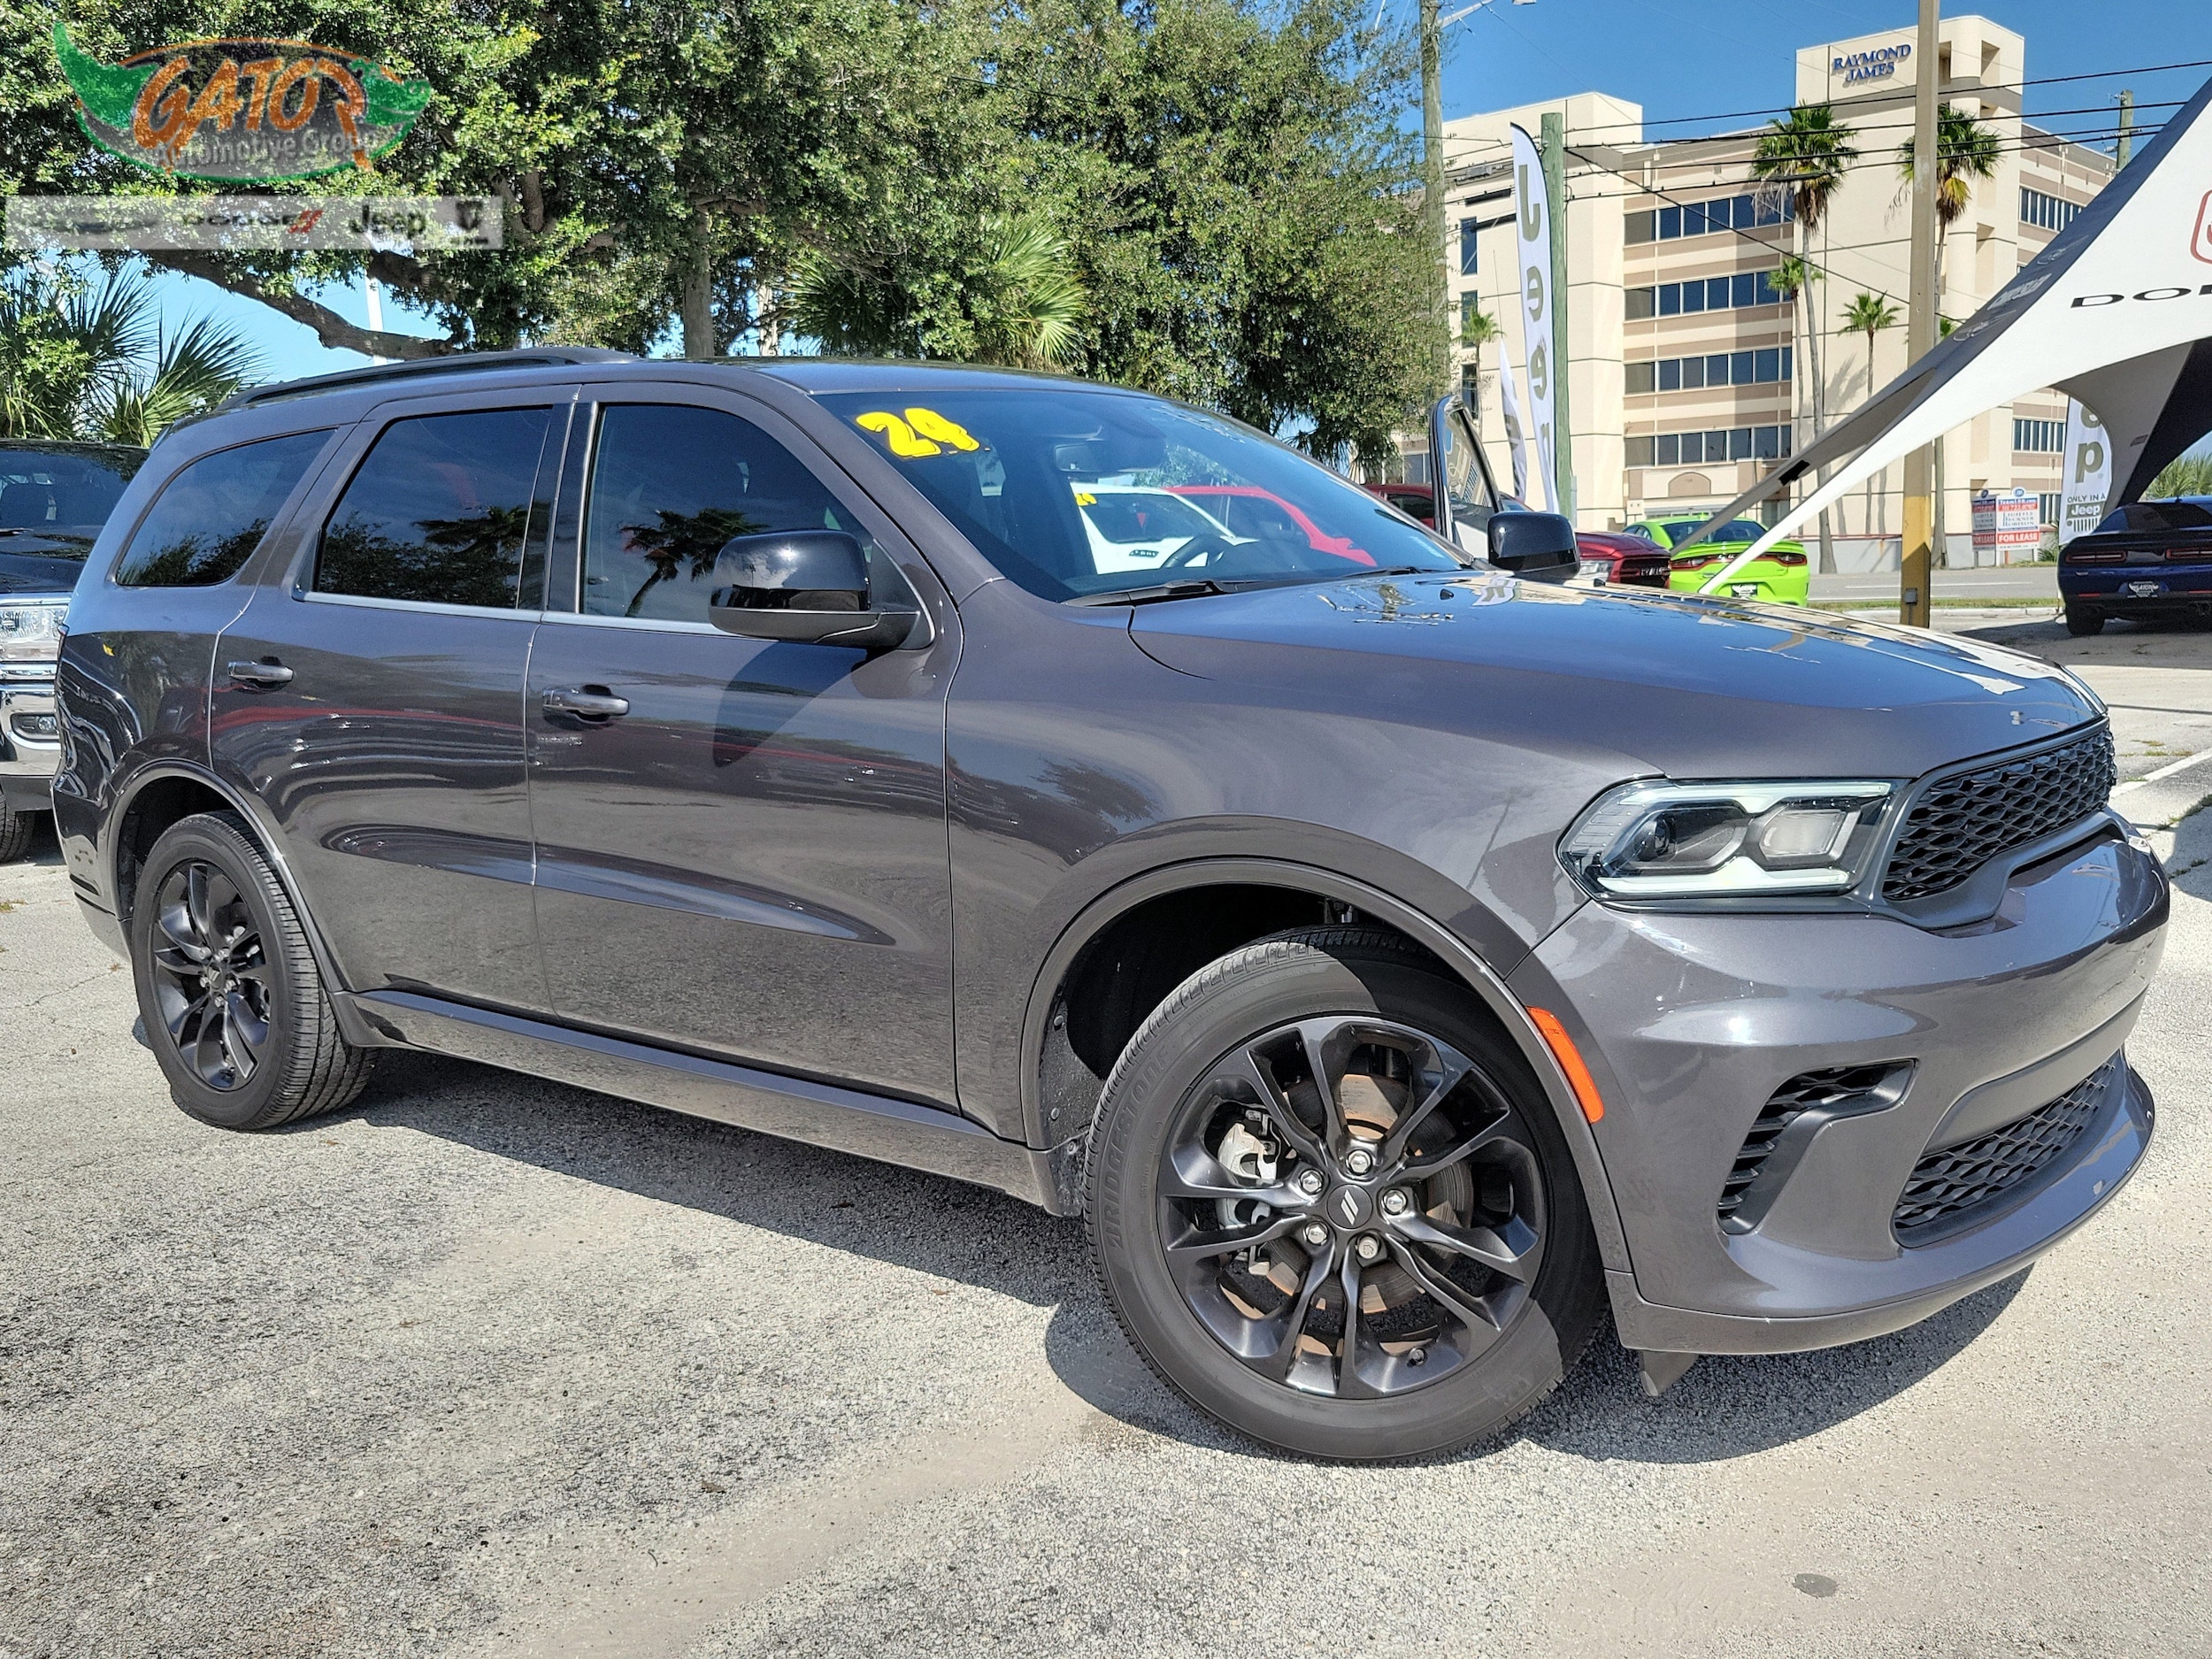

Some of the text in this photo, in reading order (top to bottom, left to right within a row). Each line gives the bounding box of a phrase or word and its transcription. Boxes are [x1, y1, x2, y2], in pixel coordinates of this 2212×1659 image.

[1833, 44, 1911, 71] RAYMOND
[1846, 61, 1895, 82] JAMES
[2070, 284, 2212, 309] DO
[856, 408, 980, 458] 24
[2071, 504, 2101, 516] Jeep
[1999, 532, 2038, 542] FOR LEASE
